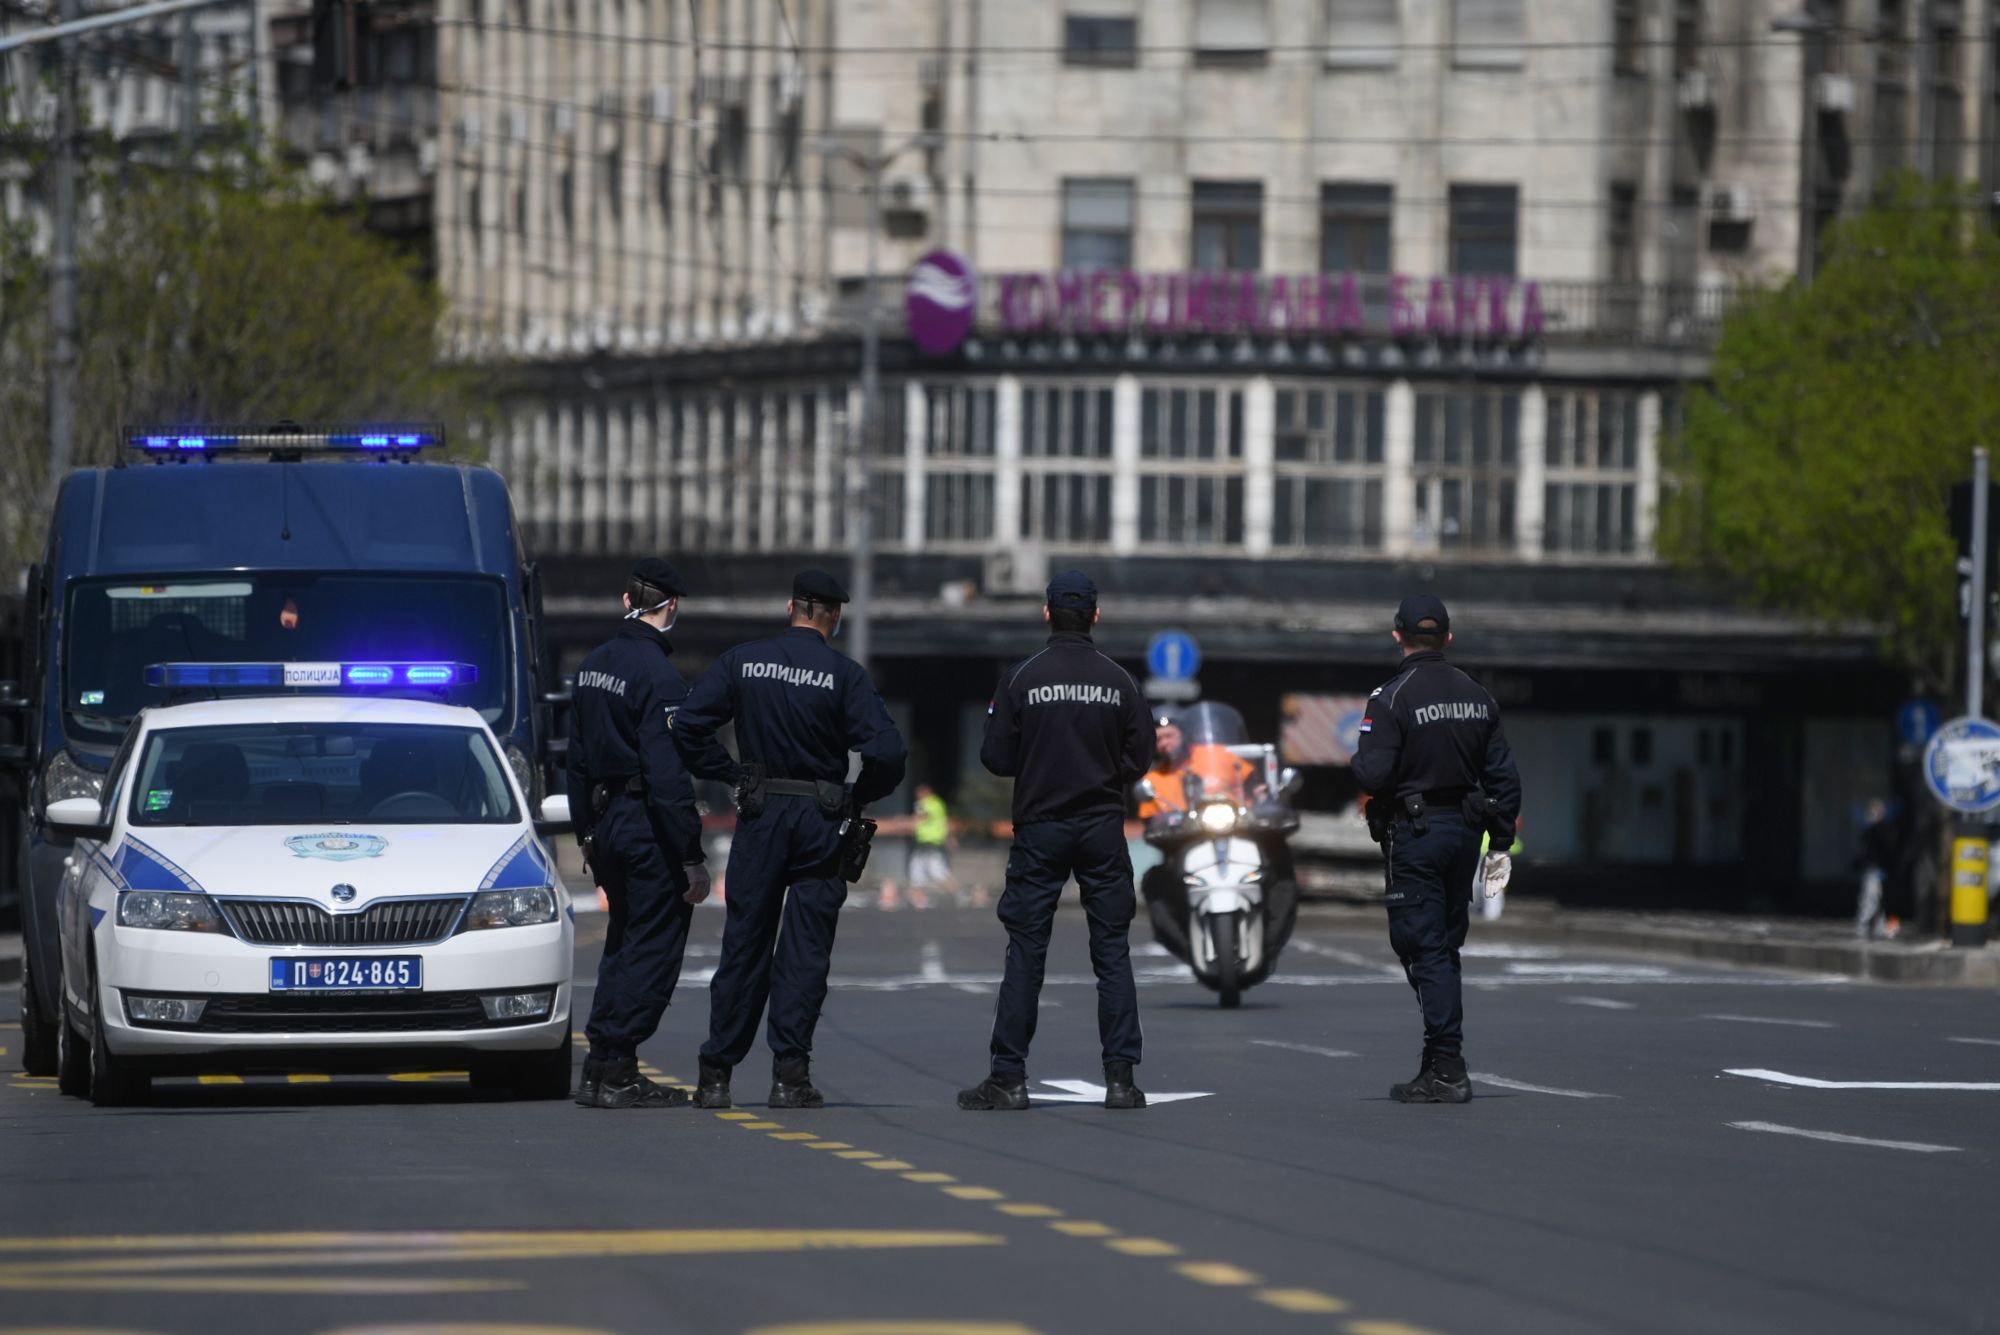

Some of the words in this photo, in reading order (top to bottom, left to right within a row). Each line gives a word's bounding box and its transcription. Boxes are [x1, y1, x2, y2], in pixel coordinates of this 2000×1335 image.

[285, 669, 340, 682] ПОЛИЦИЈА
[742, 662, 834, 690] ПОЛИЦИЈА
[1028, 684, 1121, 706] ПОЛИЦИЈА
[1415, 702, 1489, 725] ПОЛИЦИЈА
